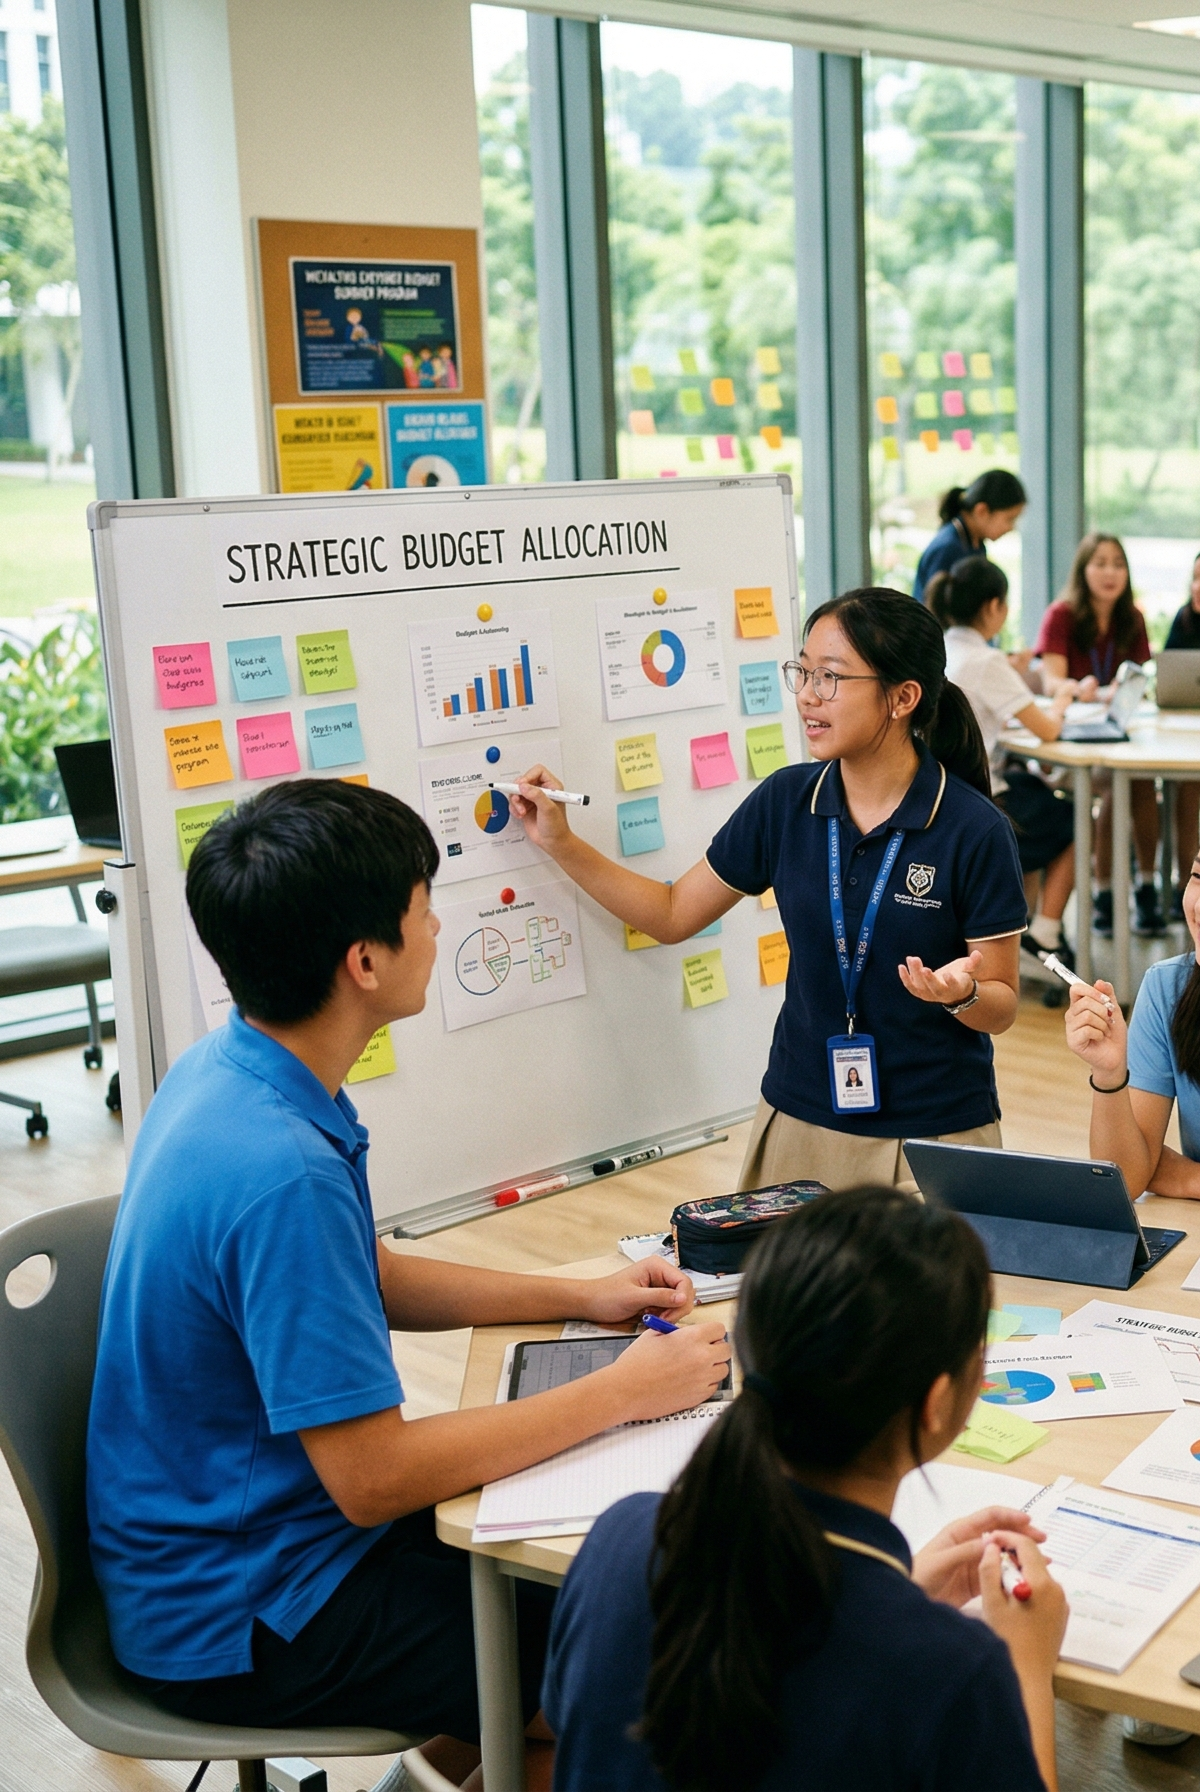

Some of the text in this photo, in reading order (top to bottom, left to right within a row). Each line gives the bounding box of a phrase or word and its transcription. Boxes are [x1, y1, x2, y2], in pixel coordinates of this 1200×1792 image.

[226, 519, 668, 584] STRATEGIC BUDGET ALLOCATION
